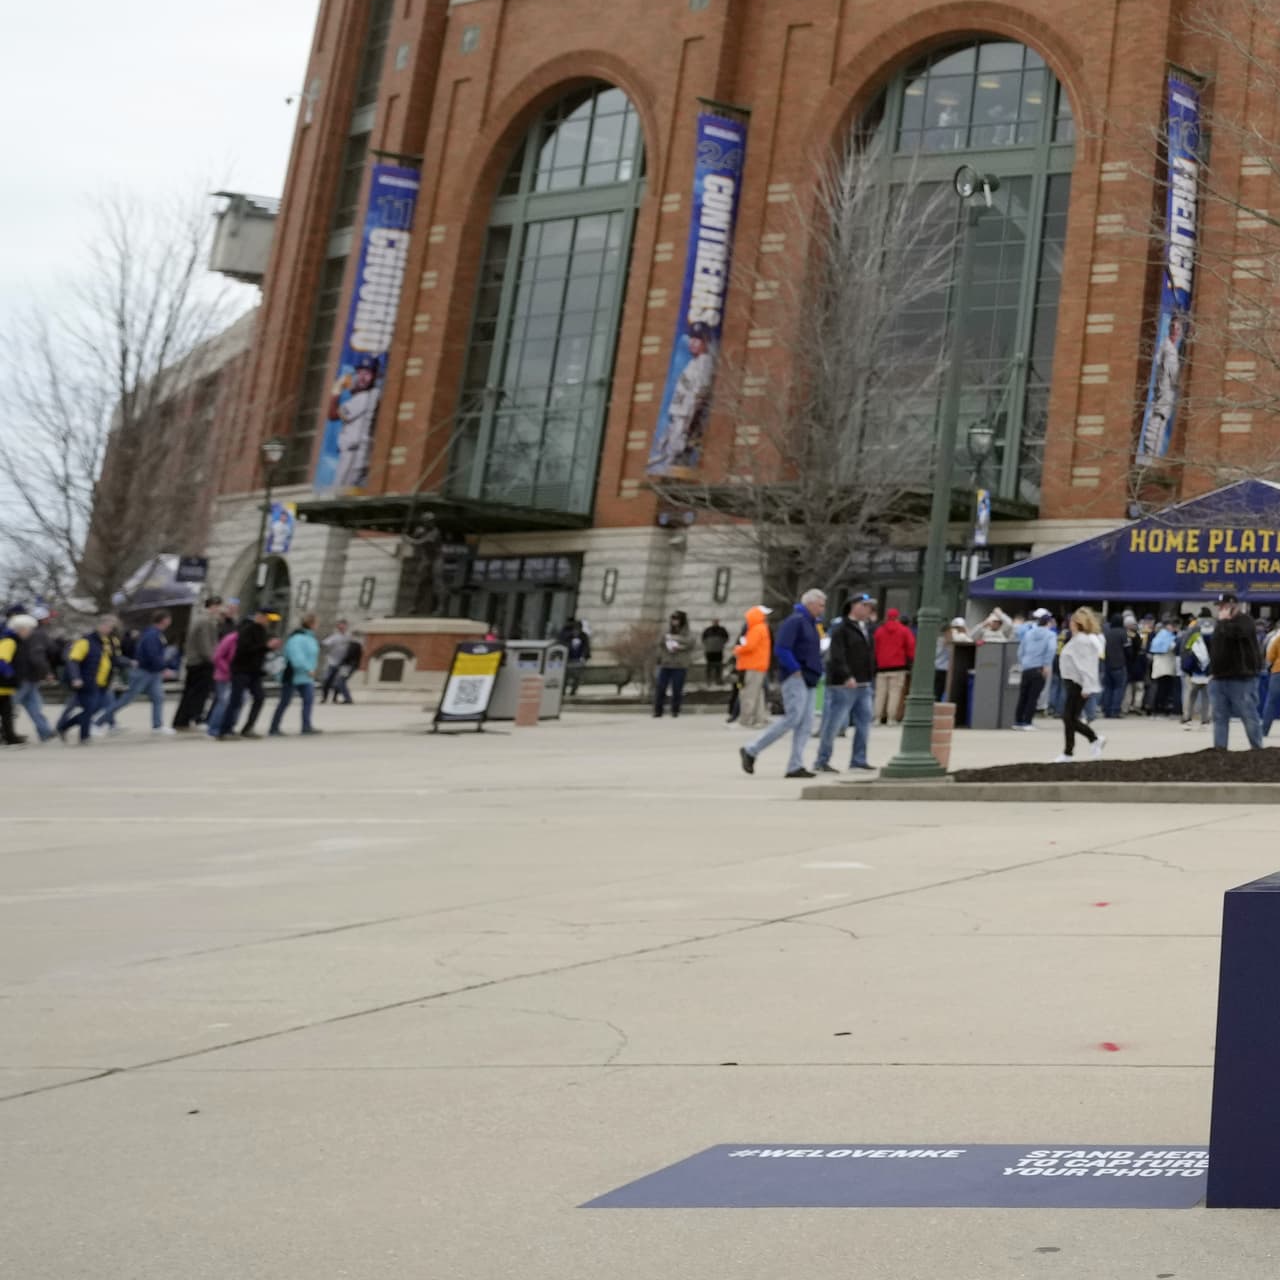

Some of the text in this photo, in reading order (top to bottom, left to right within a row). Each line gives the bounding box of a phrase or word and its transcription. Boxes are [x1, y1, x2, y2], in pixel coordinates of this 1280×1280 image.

[1167, 157, 1197, 293] FRELICK
[688, 174, 735, 327] CONTRERAS
[350, 227, 411, 353] CHOURIO
[1129, 528, 1200, 553] HOME
[1175, 558, 1219, 574] EAST
[728, 1149, 967, 1159] #WELOVEMKE
[1025, 1150, 1209, 1159] STAND HER
[1016, 1158, 1209, 1168] TO CAPTURE
[1003, 1167, 1204, 1177] YOUR PHOTO
